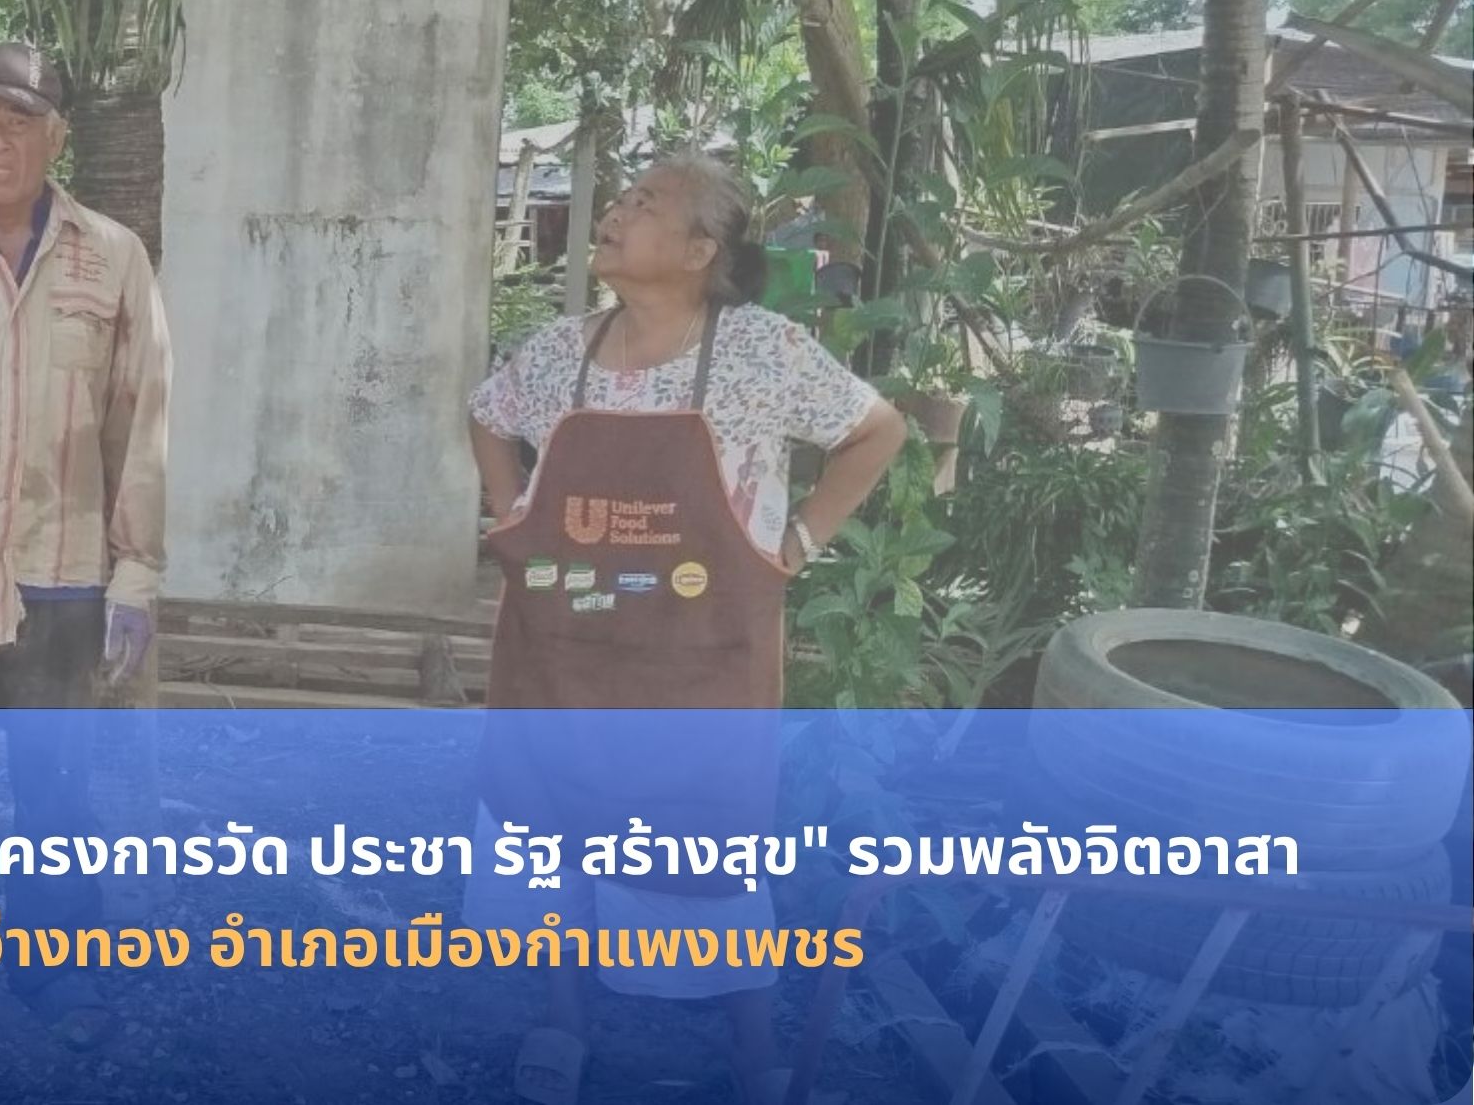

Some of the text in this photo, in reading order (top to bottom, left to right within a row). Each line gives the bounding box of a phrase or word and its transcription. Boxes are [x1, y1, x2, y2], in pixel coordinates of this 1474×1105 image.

[612, 500, 676, 515] Unilever
[612, 516, 647, 530] Food
[610, 530, 681, 545] Solutions
